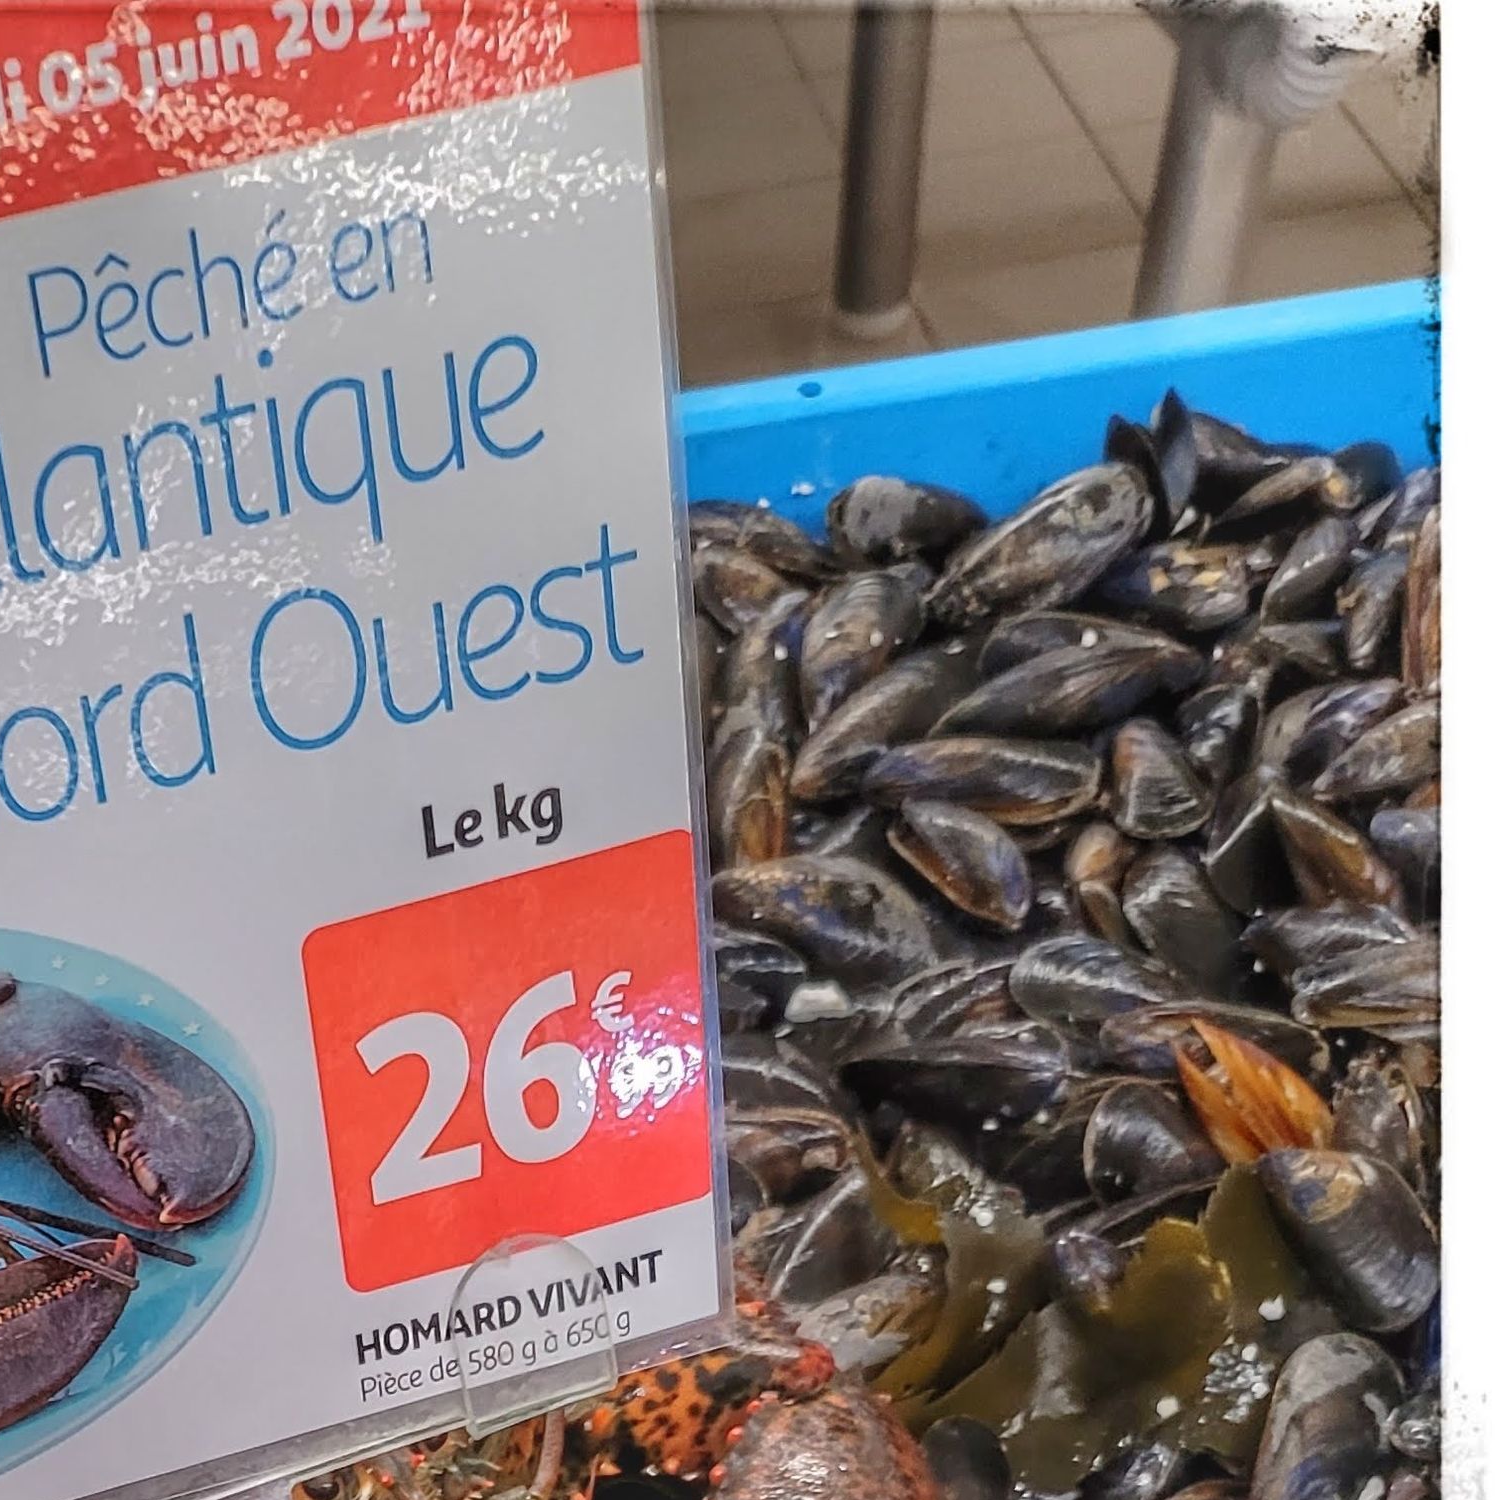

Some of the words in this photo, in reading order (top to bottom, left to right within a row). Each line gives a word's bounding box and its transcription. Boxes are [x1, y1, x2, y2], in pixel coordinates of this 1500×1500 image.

[38, 38, 124, 115] 05
[135, 11, 261, 114] juin
[27, 207, 304, 379] Pêché
[327, 208, 435, 302] en
[250, 522, 646, 751] Ouest
[421, 803, 483, 859] Le
[494, 783, 564, 845] kg
[354, 1294, 522, 1365] HOMARD
[526, 1249, 663, 1318] VIVANT
[360, 1370, 424, 1402] Pièce
[429, 1355, 459, 1383] de
[468, 1341, 513, 1376] 580
[521, 1340, 538, 1367] g
[544, 1328, 559, 1354] à
[615, 1309, 631, 1337] g
